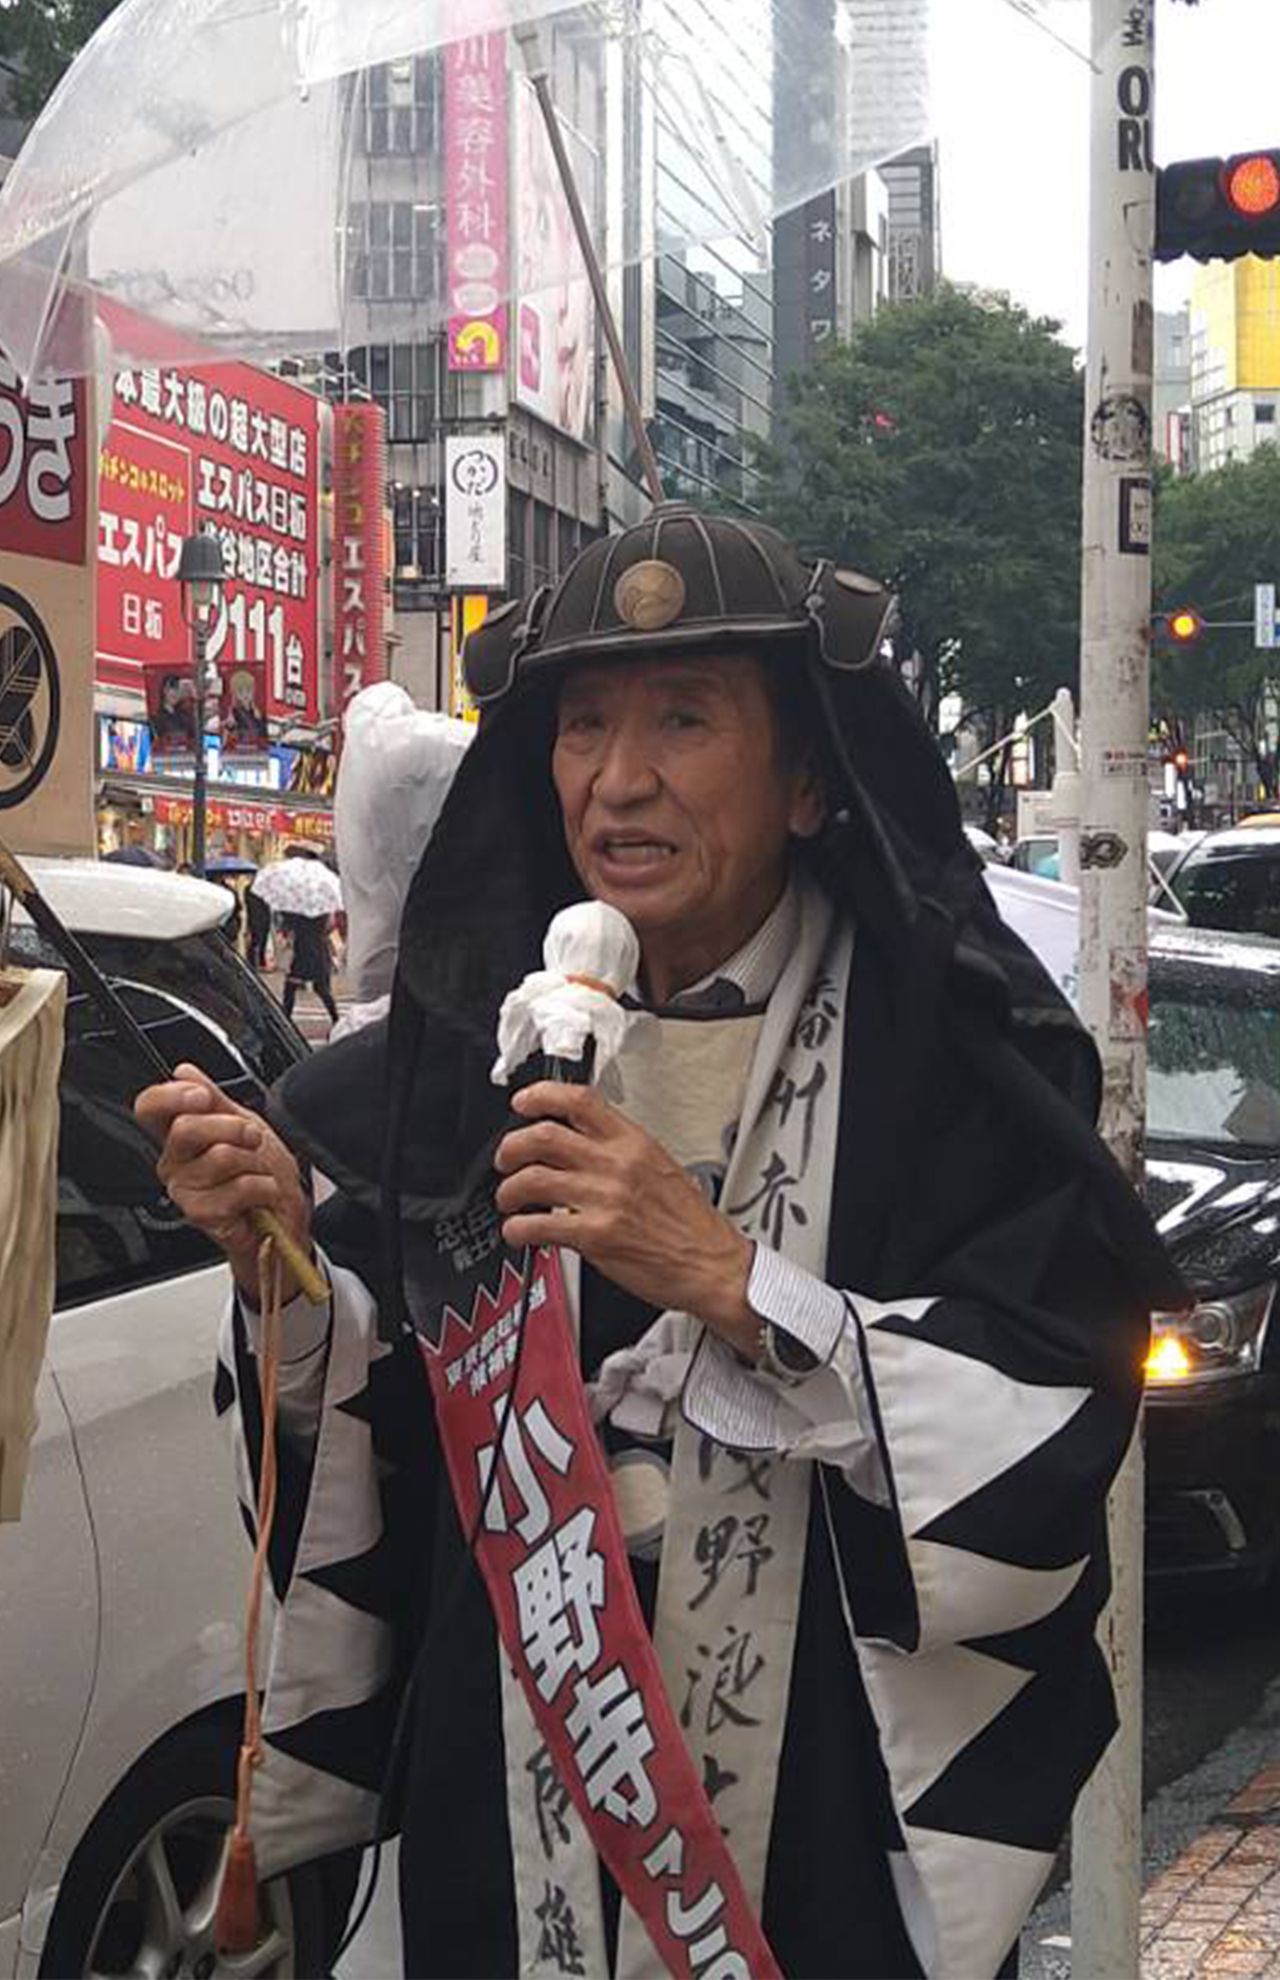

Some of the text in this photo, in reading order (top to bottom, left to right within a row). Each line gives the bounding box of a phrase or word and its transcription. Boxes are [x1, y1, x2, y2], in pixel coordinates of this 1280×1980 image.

[203, 520, 307, 598] 谷地区合計
